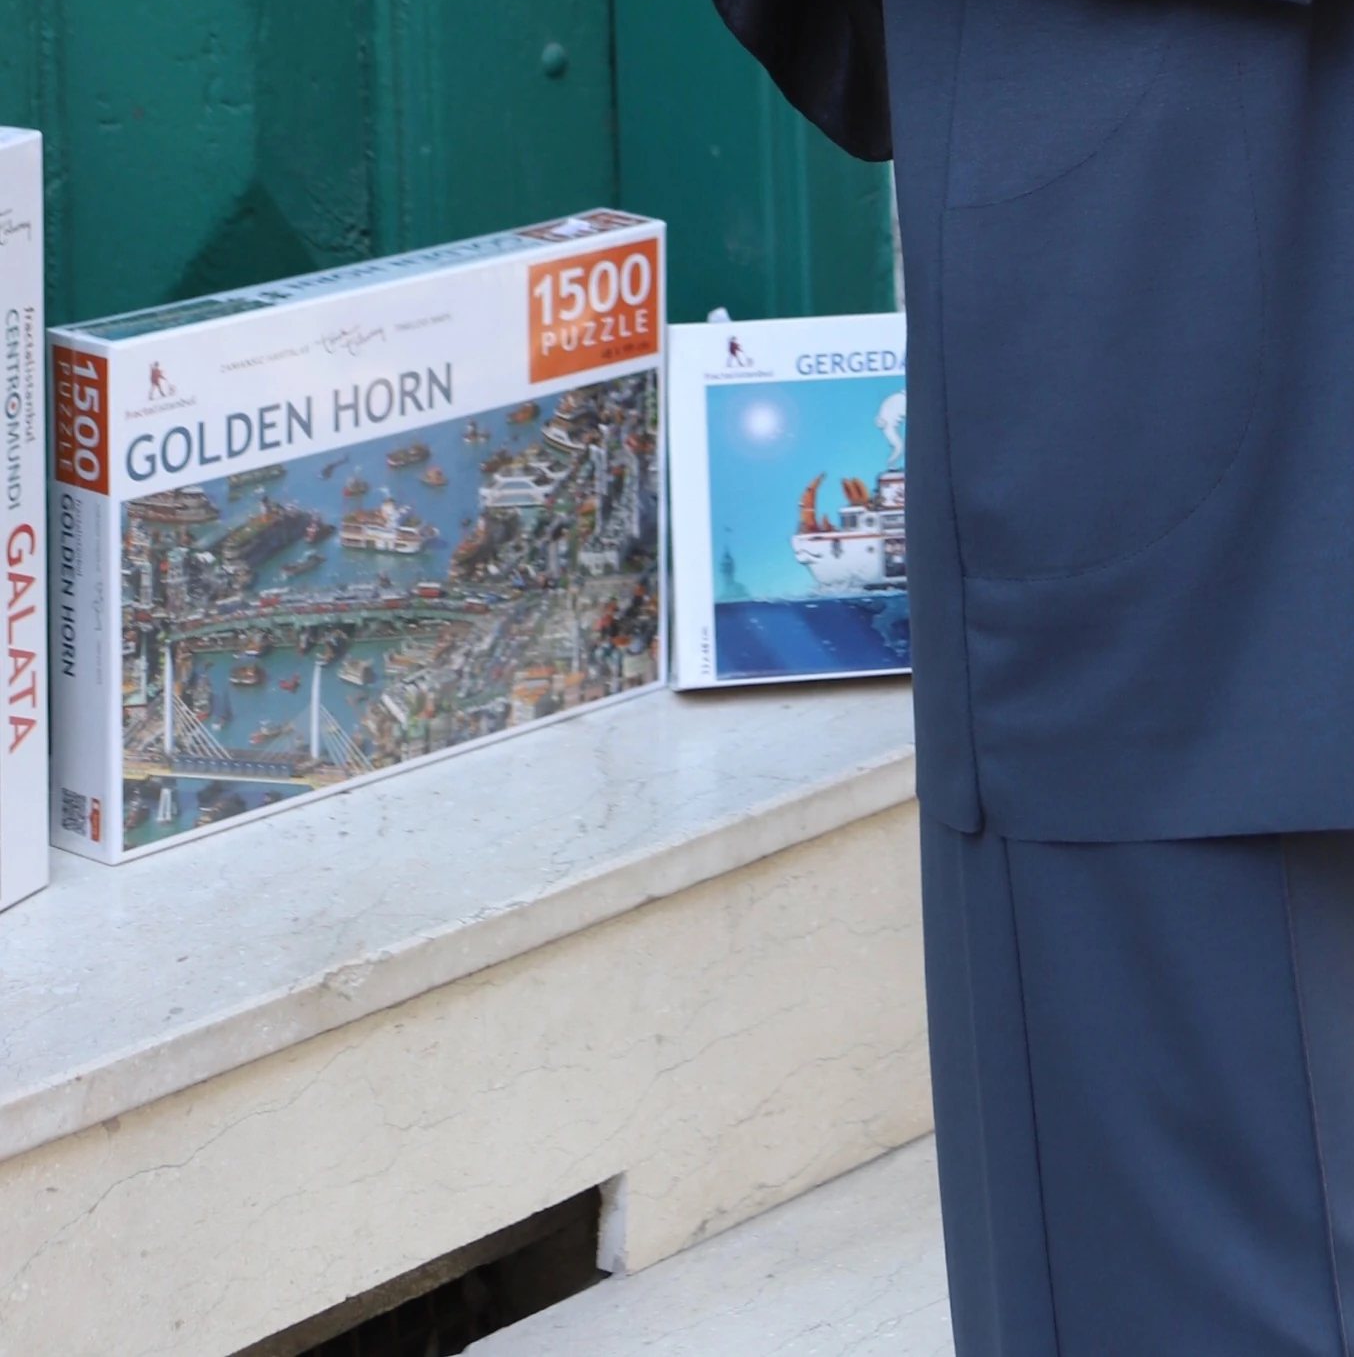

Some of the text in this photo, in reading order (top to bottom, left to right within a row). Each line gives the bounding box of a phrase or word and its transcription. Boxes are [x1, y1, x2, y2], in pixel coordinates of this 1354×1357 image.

[534, 252, 651, 326] 1500
[541, 308, 649, 357] PUZZLE
[58, 360, 74, 474] PUZZLE
[72, 359, 101, 482] 1500
[796, 350, 907, 376] GERGED
[125, 362, 453, 482] GOLDEN HORN
[6, 523, 37, 755] GALATA
[60, 493, 76, 678] GOLDEN HORN
